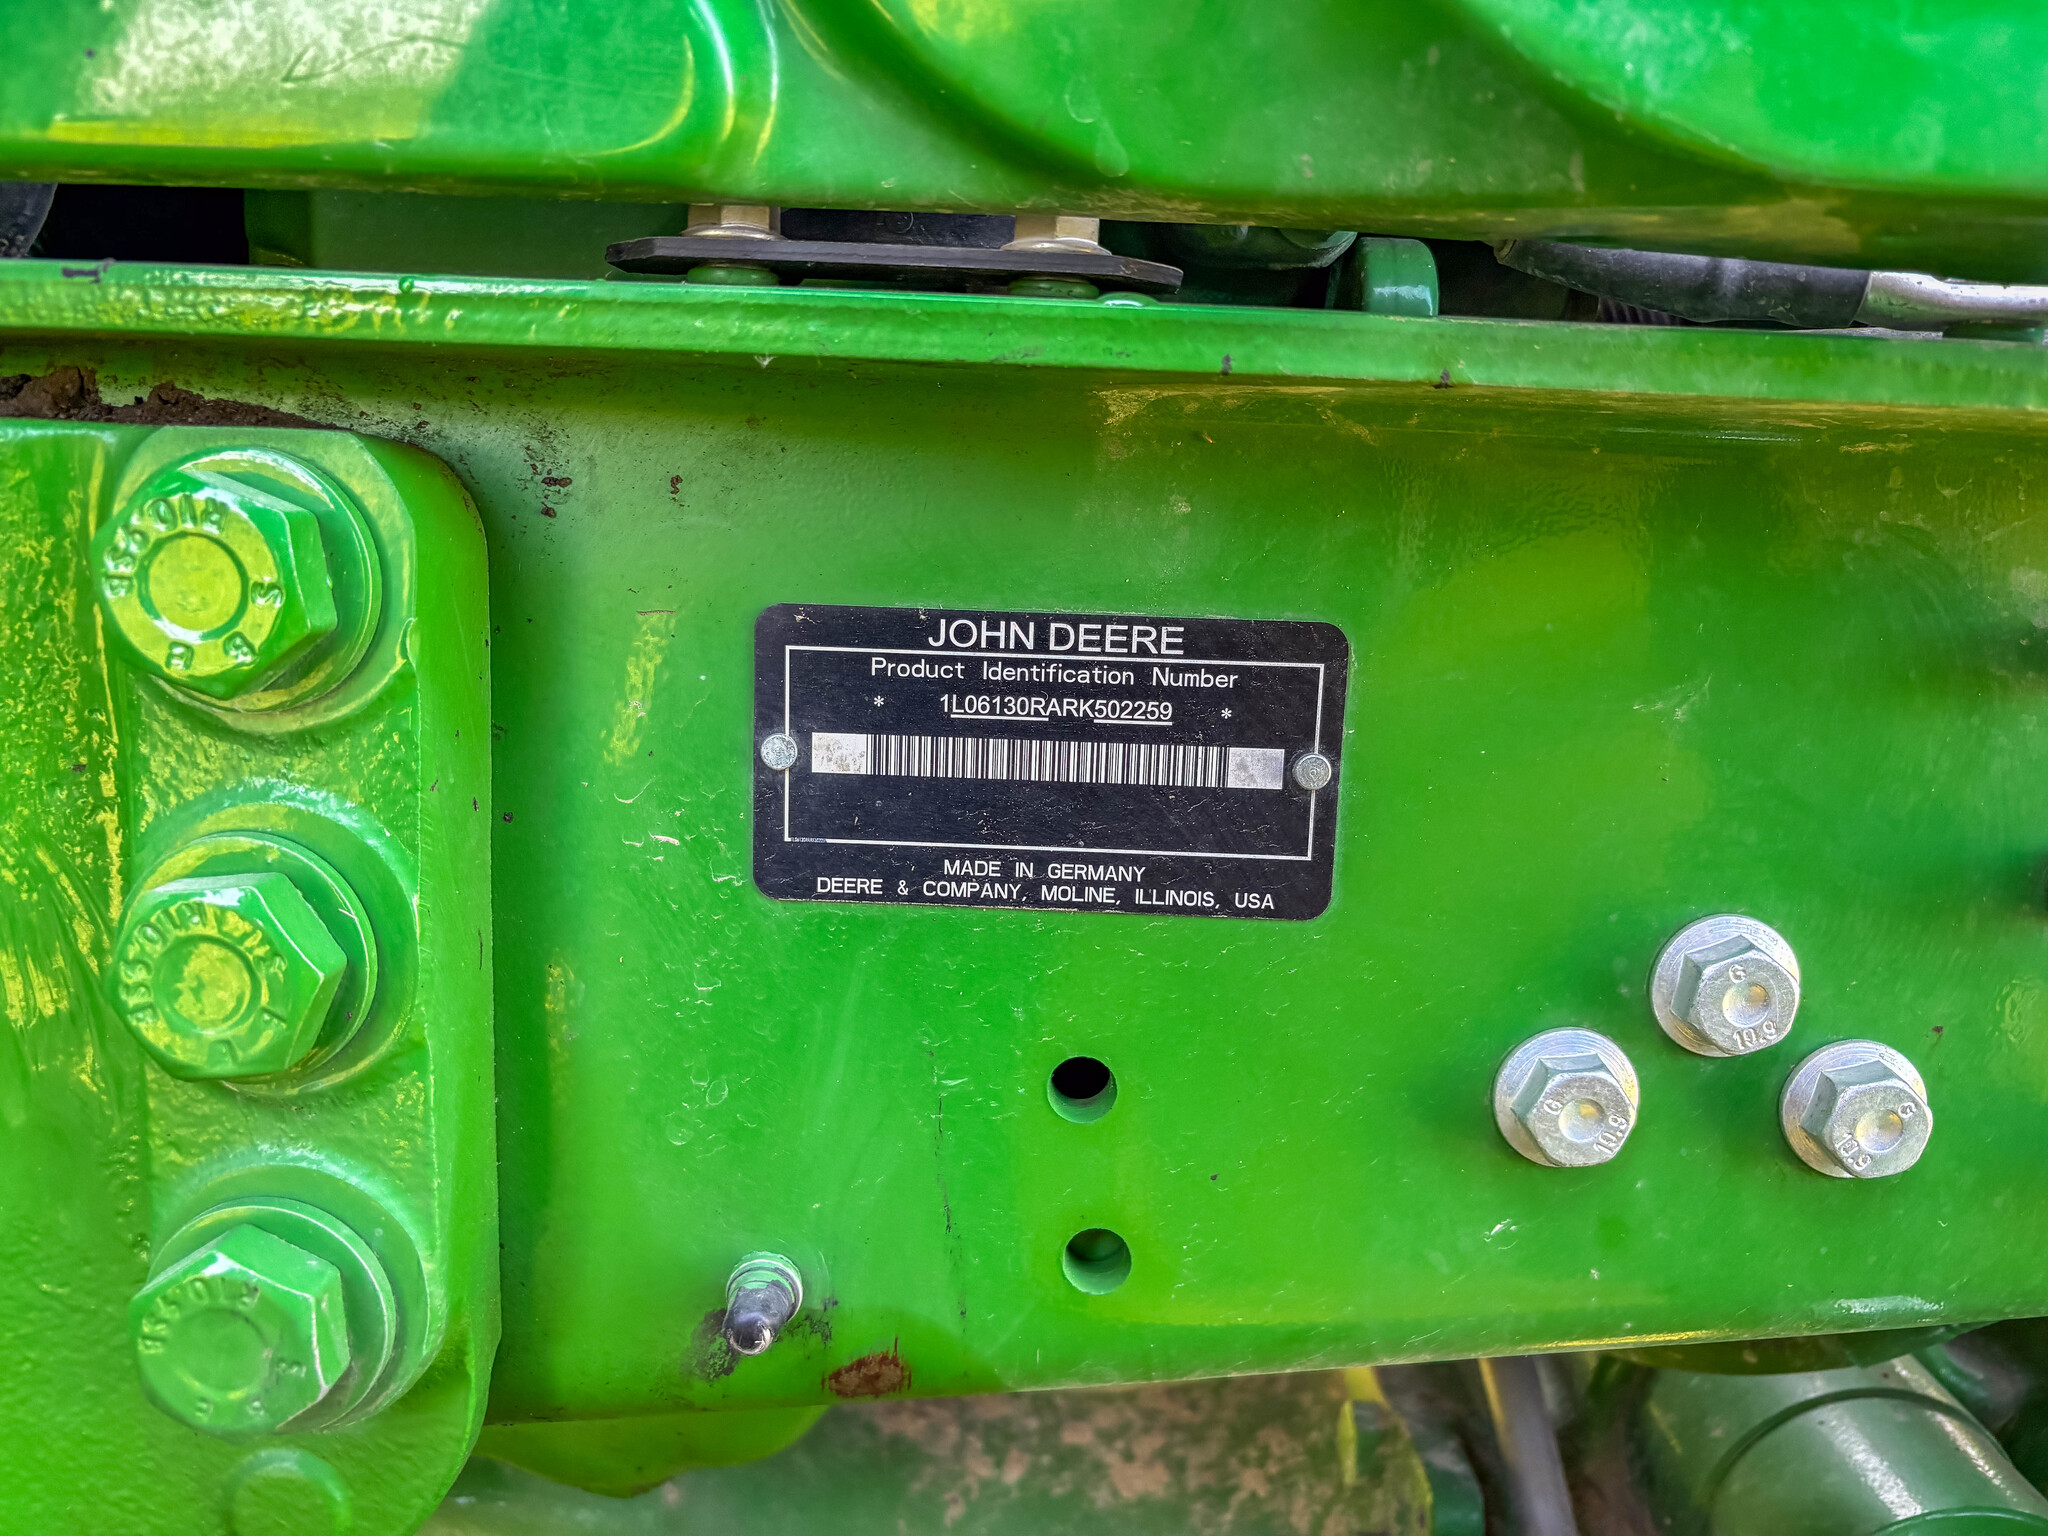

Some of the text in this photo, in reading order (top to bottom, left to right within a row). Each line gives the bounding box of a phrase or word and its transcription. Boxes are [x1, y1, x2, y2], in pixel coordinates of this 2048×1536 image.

[927, 618, 1185, 655] JOHN DEERE
[871, 656, 1239, 689] Product Identification Number
[940, 693, 1173, 721] 1L06130RARK502259
[943, 859, 1146, 883] MADE IN GERMANY
[816, 876, 1275, 910] DEERE & COMPANY, MOLINE, ILLINOIS, USA
